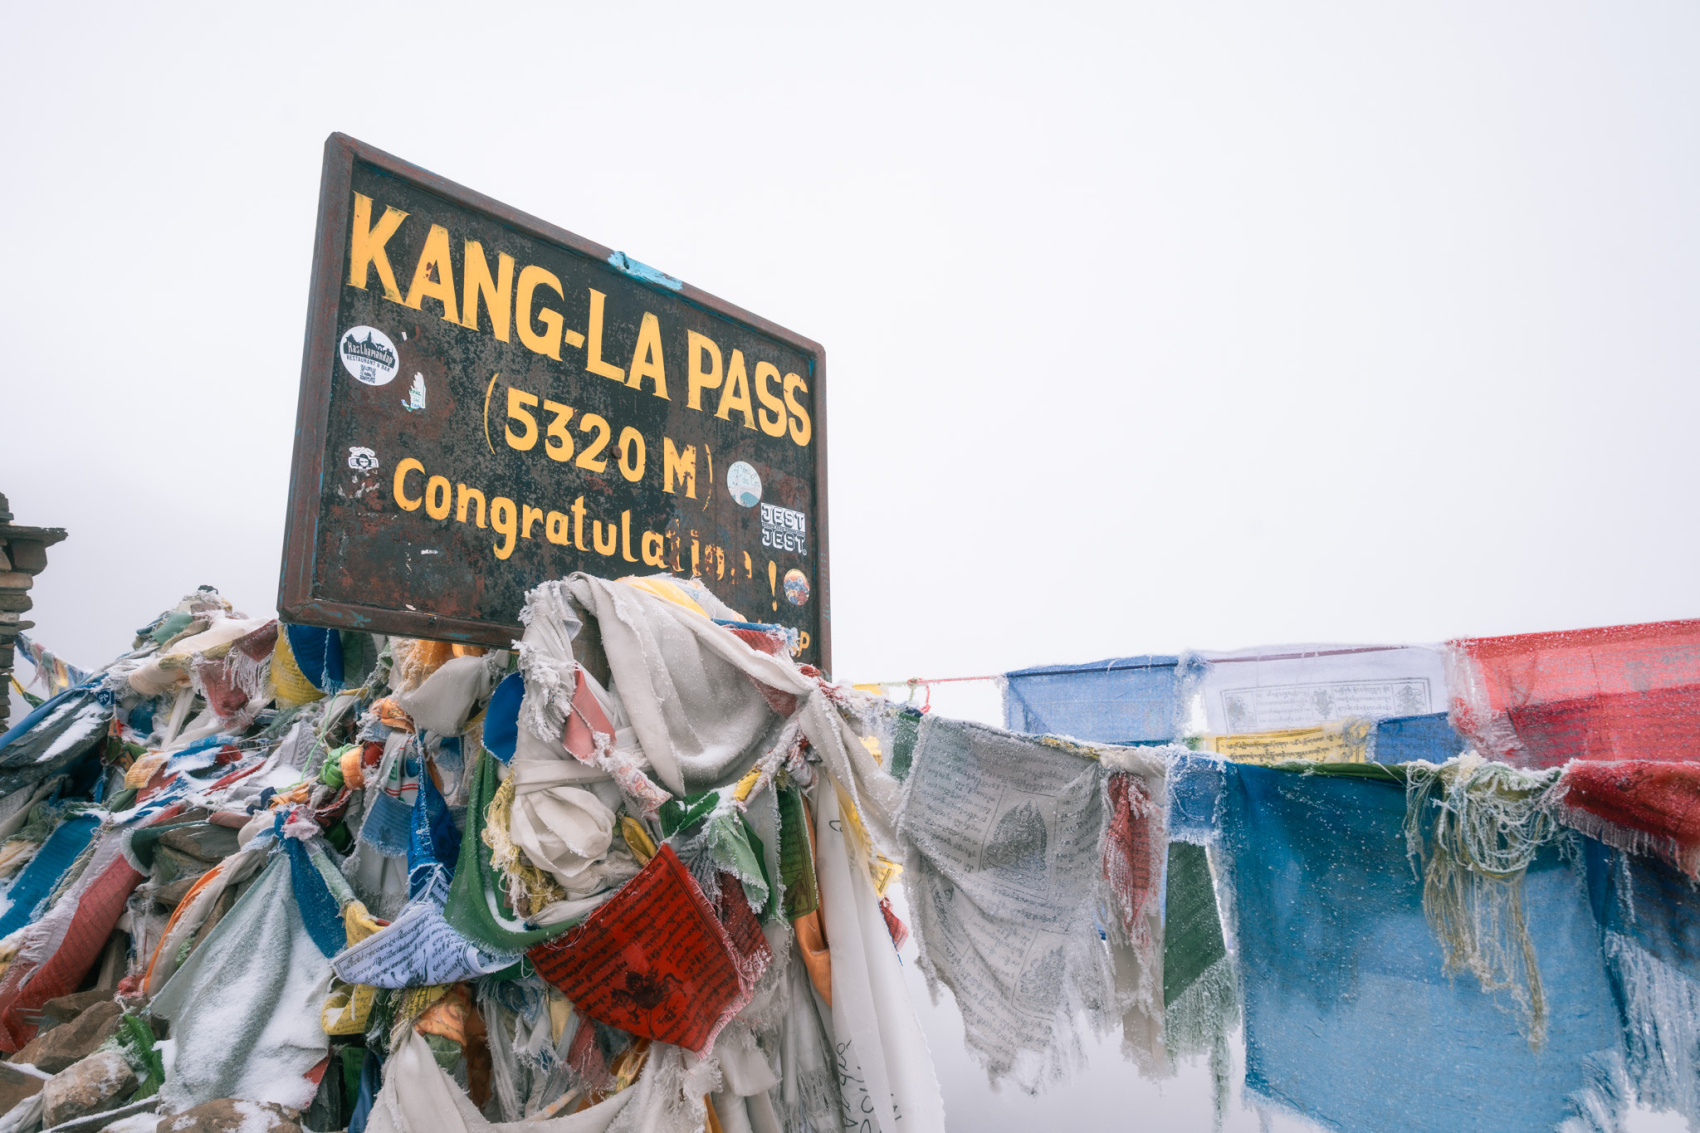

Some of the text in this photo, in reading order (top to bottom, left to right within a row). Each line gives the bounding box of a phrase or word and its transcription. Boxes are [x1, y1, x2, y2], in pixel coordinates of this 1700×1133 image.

[346, 190, 813, 447] KANG-LA PASS
[346, 354, 376, 367] RESTAURANT
[381, 364, 391, 373] BAR
[761, 503, 805, 530] JEST
[761, 528, 805, 554] JEST
